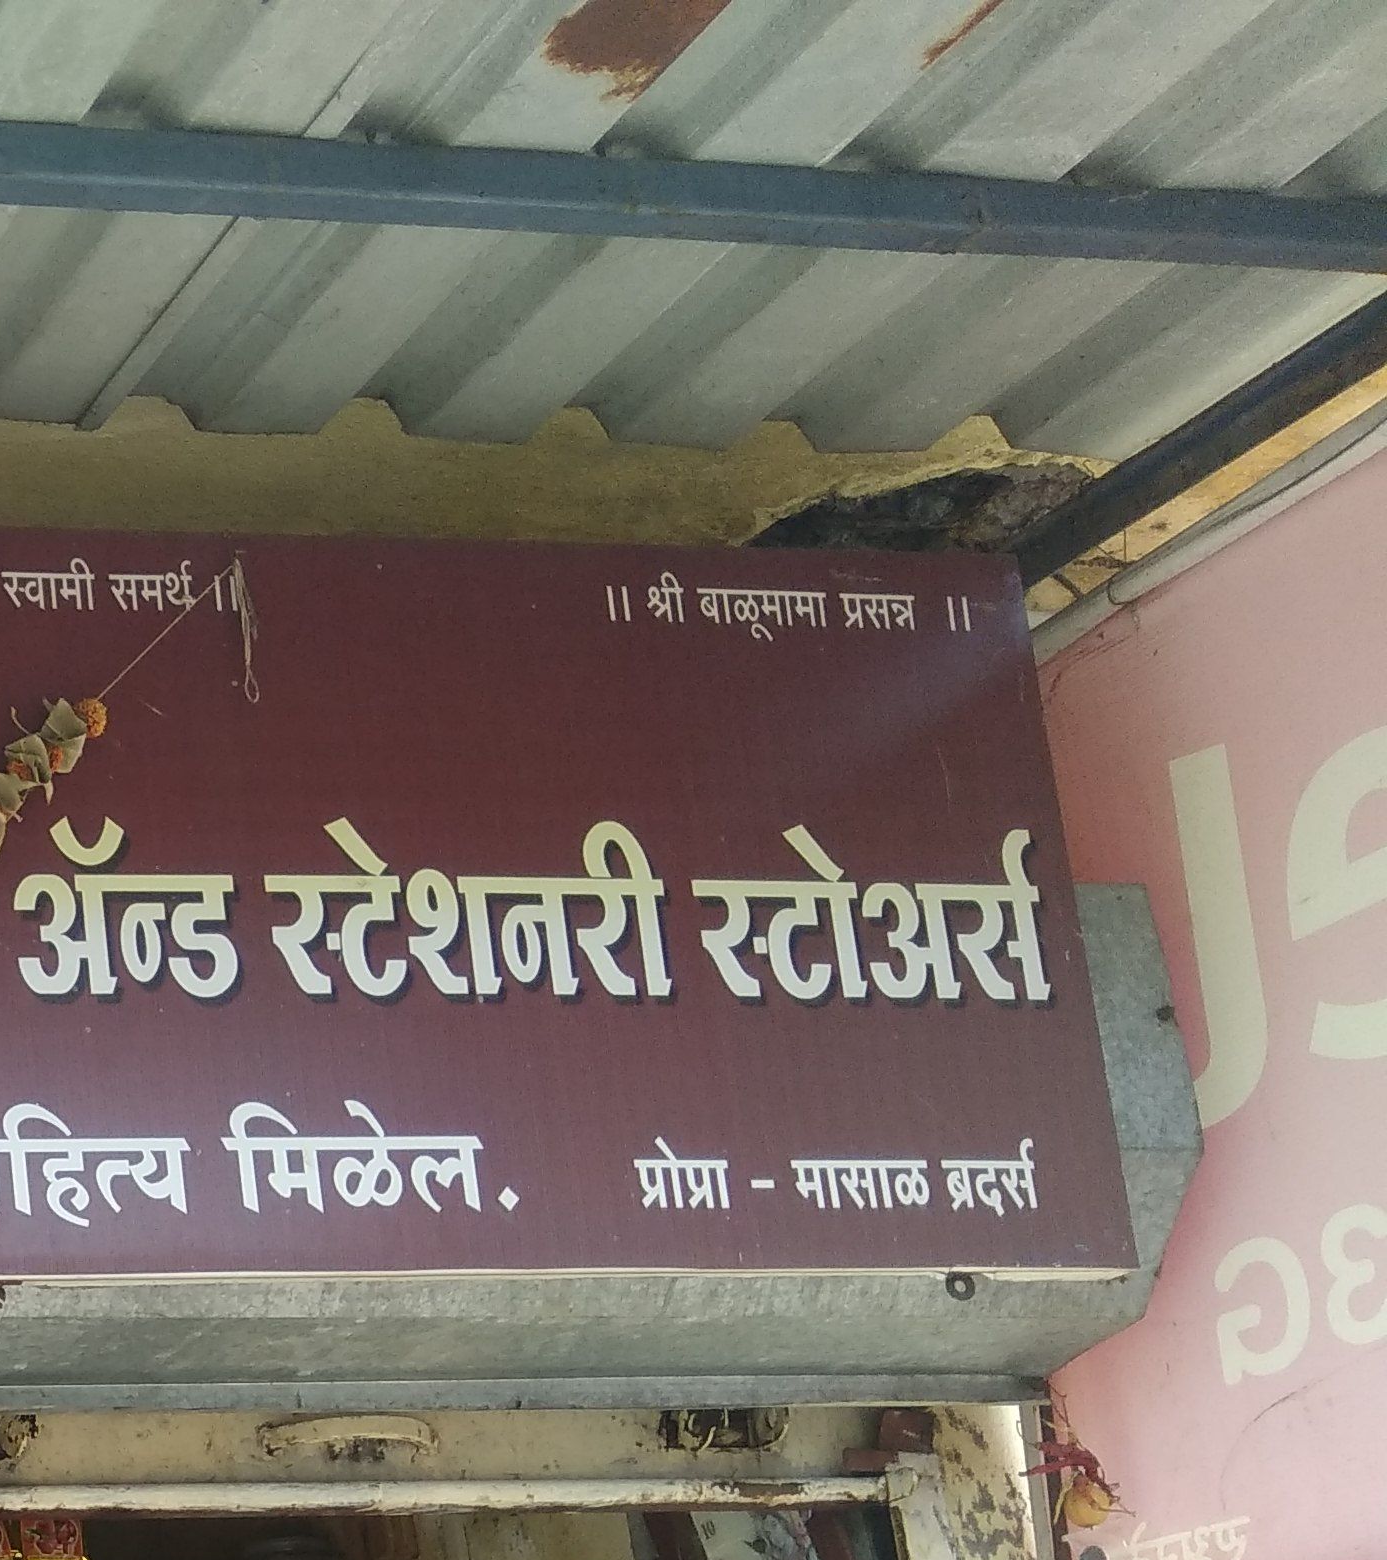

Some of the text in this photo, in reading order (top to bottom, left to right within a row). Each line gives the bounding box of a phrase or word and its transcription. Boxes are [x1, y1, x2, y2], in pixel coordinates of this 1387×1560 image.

[1, 557, 95, 612] स्वामी
[109, 560, 195, 612] समर्थ
[646, 571, 685, 623] श्री
[696, 587, 827, 641] बाळूमामा
[839, 592, 915, 632] प्रसन्न
[264, 817, 673, 997] स्टेशनरी
[692, 824, 1052, 1002] स्टोअर्स
[634, 1136, 730, 1211] प्रोप्रा
[791, 1158, 930, 1211] मासाळ
[941, 1137, 1039, 1218] ब्रदर्स
[701, 1519, 717, 1541] 10
